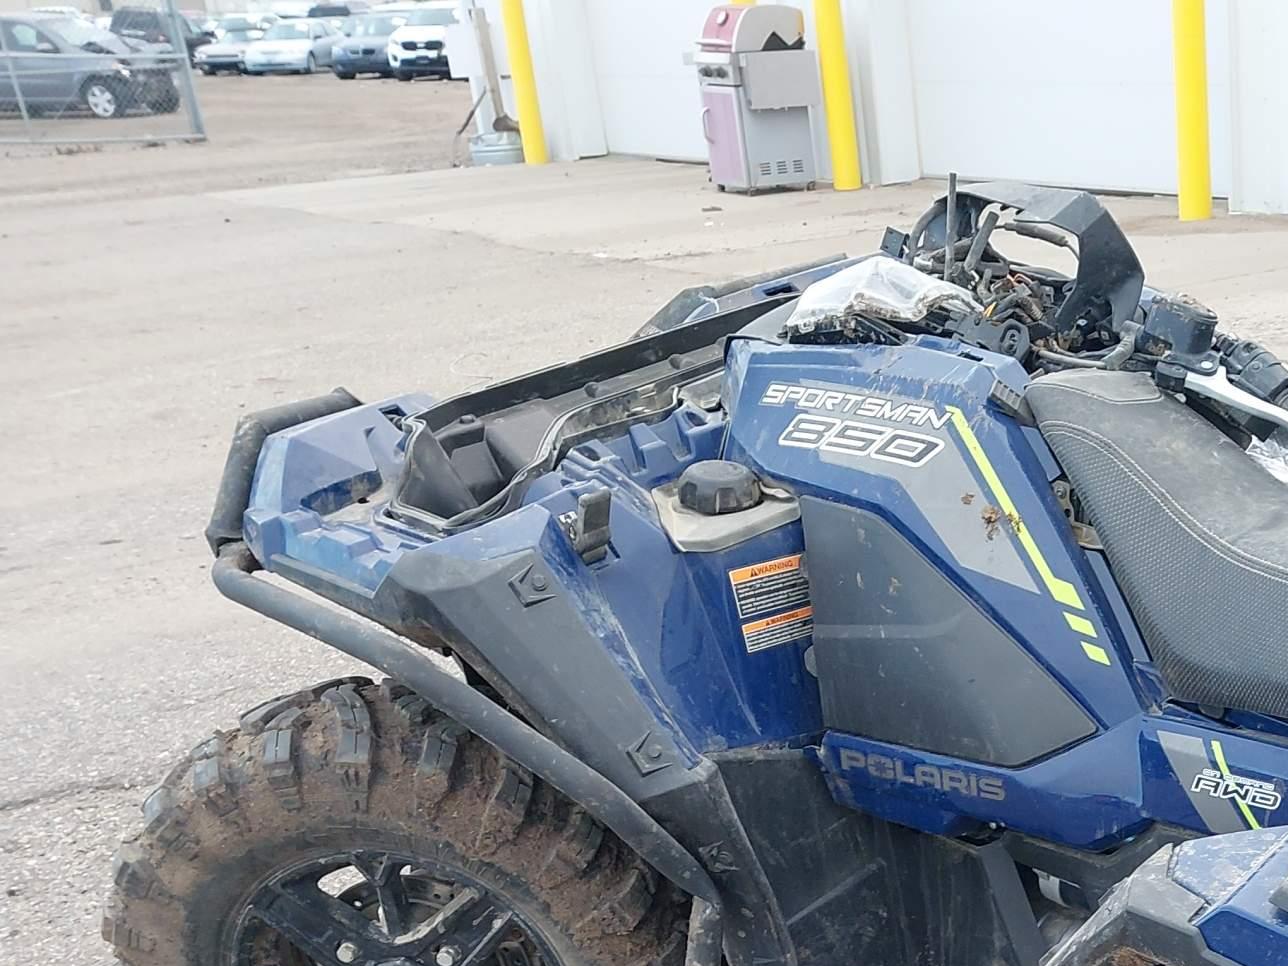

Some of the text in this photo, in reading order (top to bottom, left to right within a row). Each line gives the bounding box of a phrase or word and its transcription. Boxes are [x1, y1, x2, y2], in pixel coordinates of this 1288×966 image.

[760, 383, 952, 430] SPORTSMAN
[778, 413, 946, 469] 850
[757, 560, 794, 575] WARNING
[839, 747, 1007, 801] POLARIS
[1191, 774, 1282, 811] AWD
